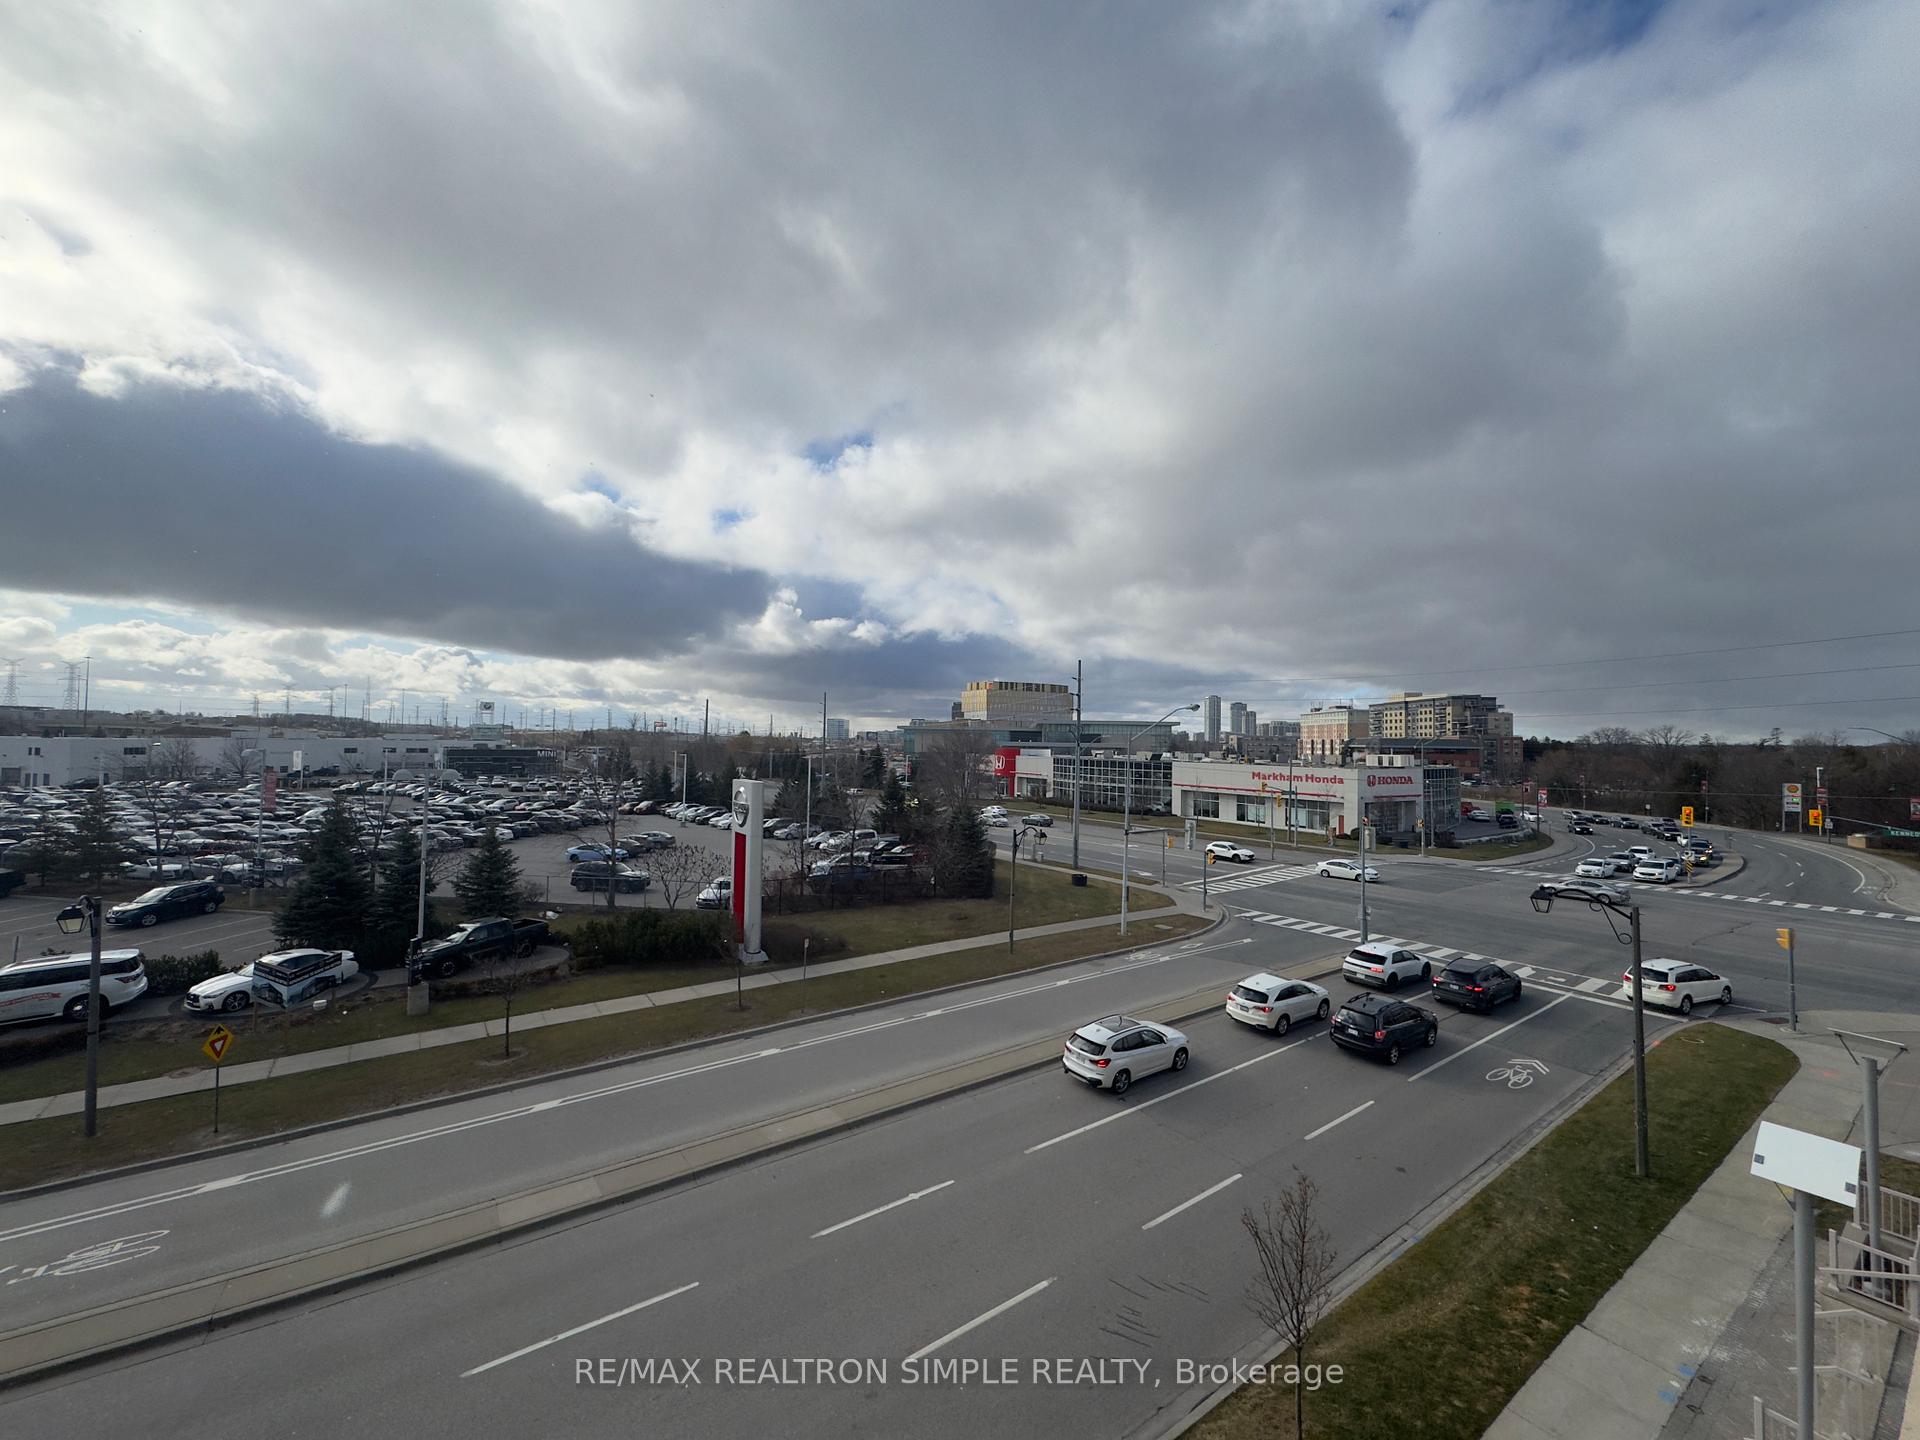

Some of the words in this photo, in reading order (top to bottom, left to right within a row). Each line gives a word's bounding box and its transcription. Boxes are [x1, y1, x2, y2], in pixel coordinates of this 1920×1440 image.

[537, 750, 556, 758] MINI
[1251, 771, 1303, 783] Markham
[1305, 774, 1344, 785] Honda
[1377, 775, 1414, 785] HONDA
[1890, 830, 1920, 838] KENNED
